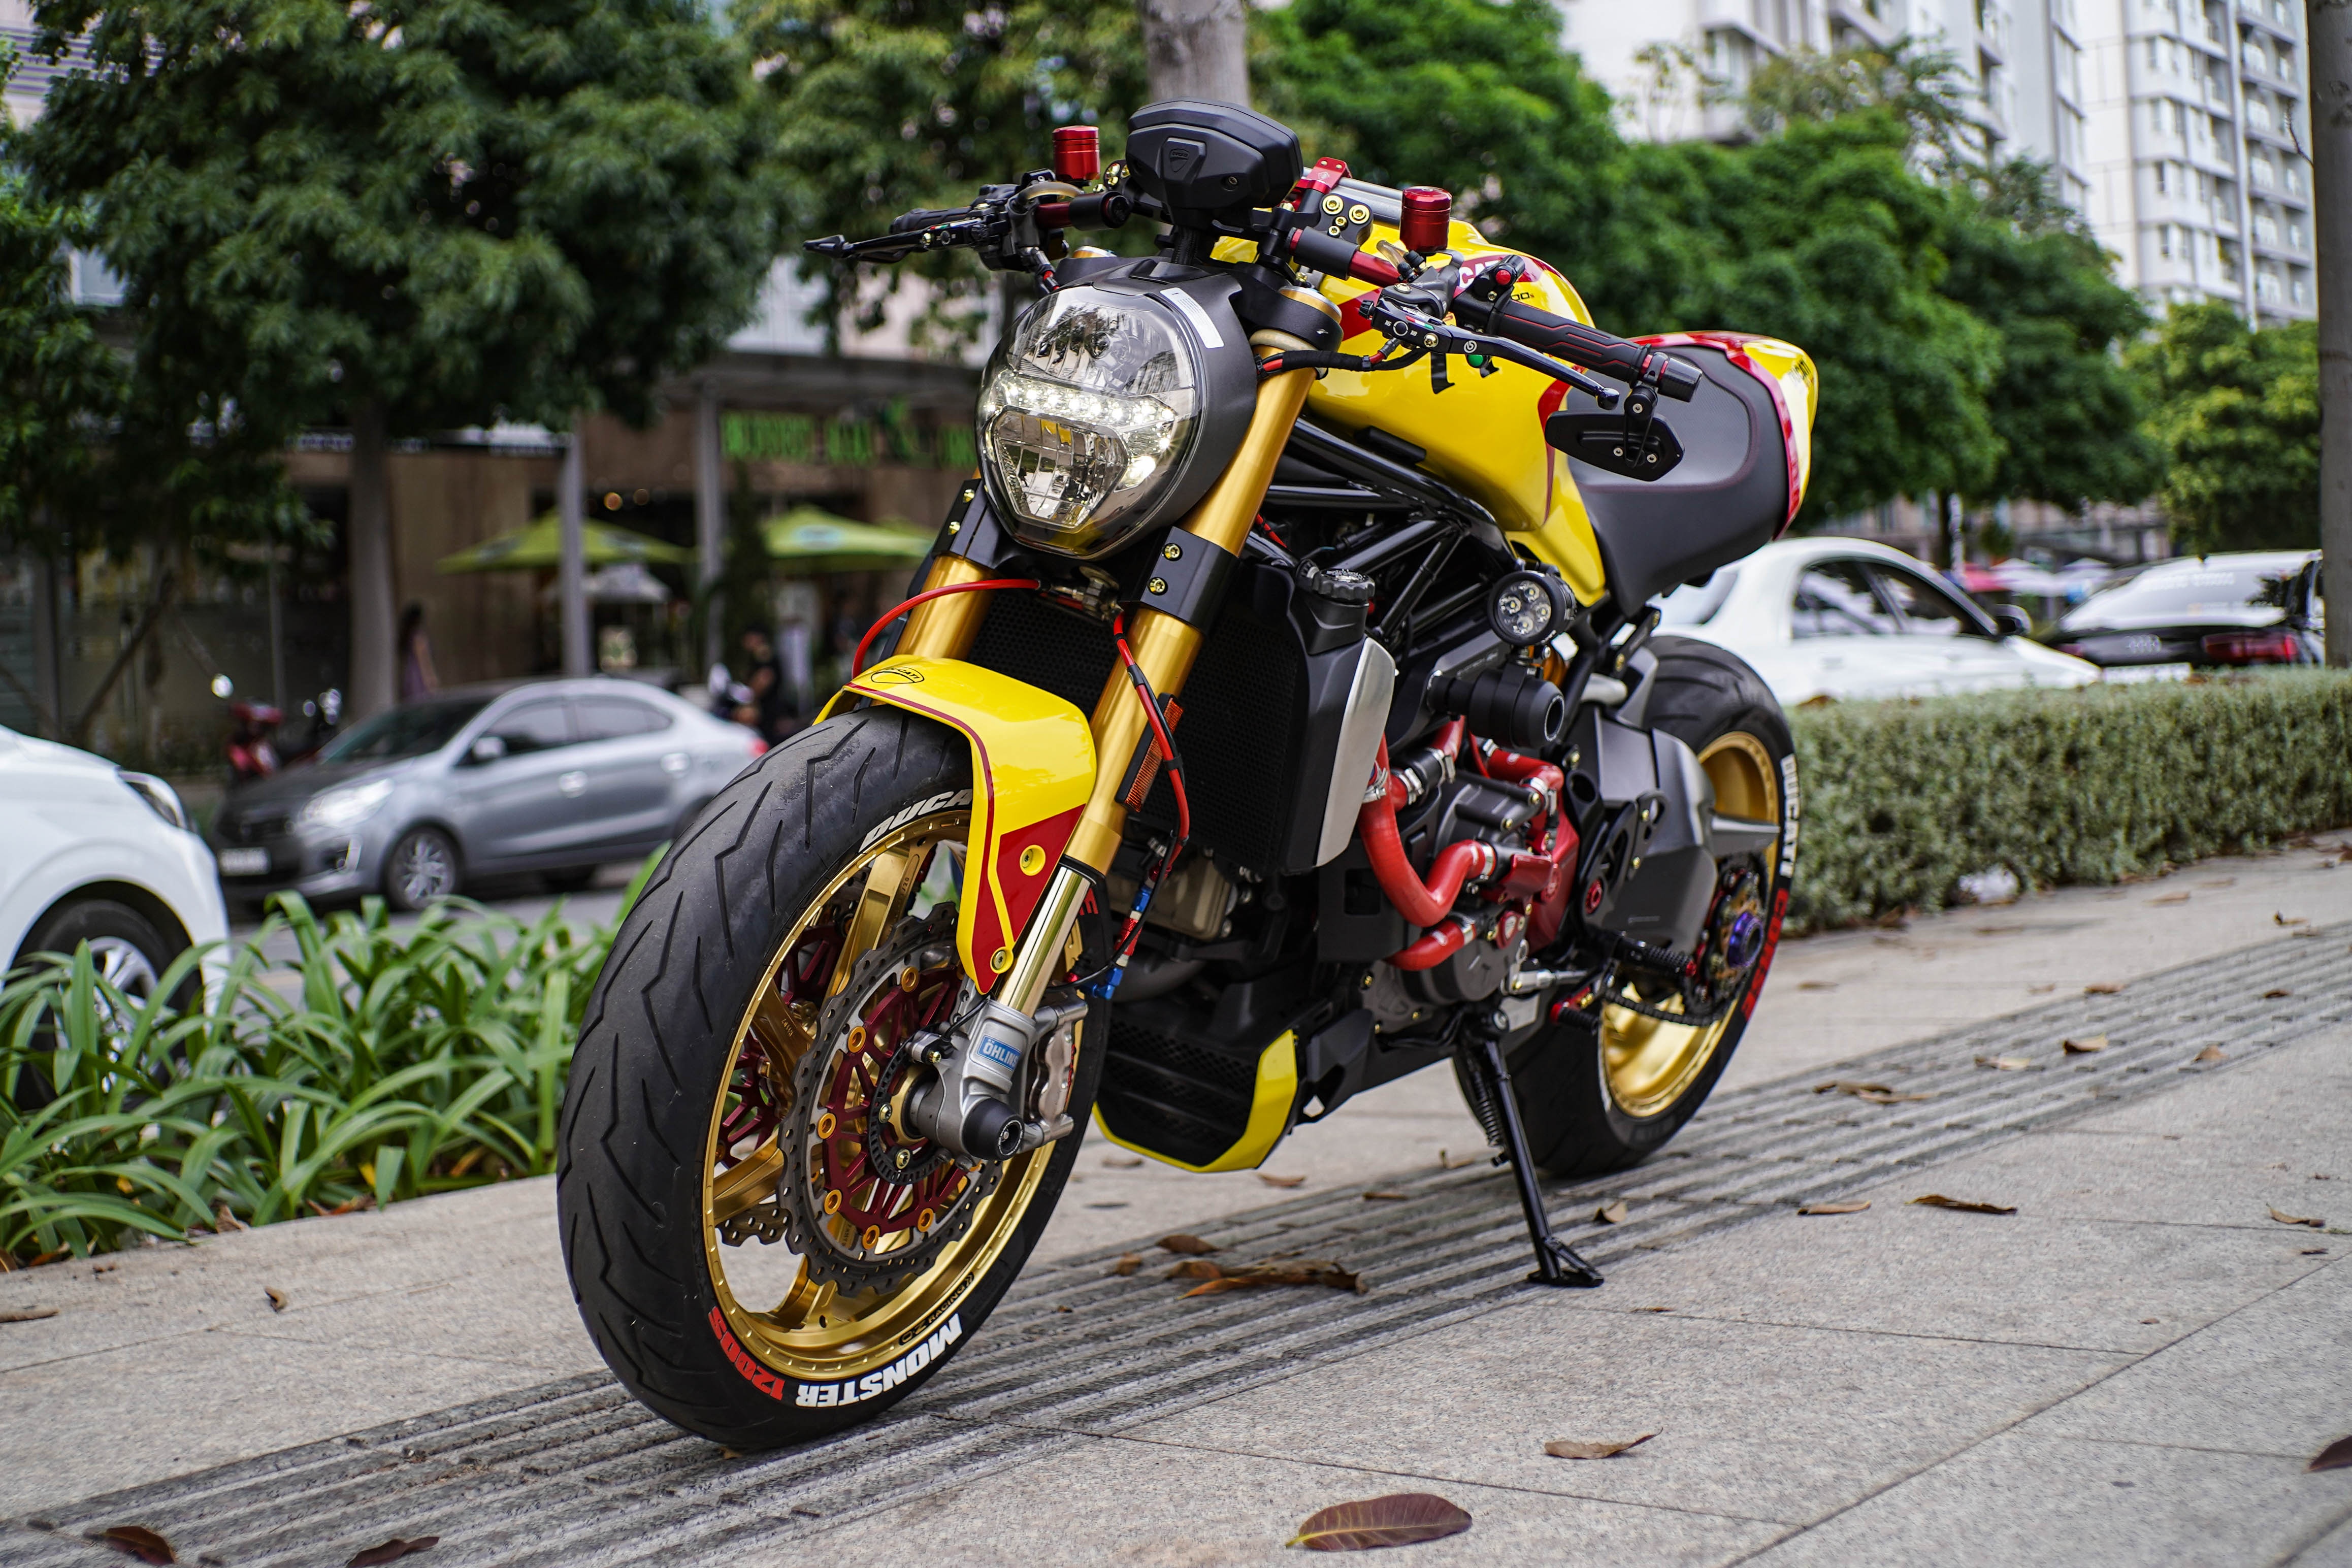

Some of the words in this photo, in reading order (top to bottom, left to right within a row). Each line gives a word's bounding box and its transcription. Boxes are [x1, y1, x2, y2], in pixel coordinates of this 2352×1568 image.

[1780, 753, 1800, 878] DUCATI
[928, 1285, 965, 1324] RACING
[708, 1306, 785, 1401] 1200S
[795, 1313, 963, 1408] MONSTER
